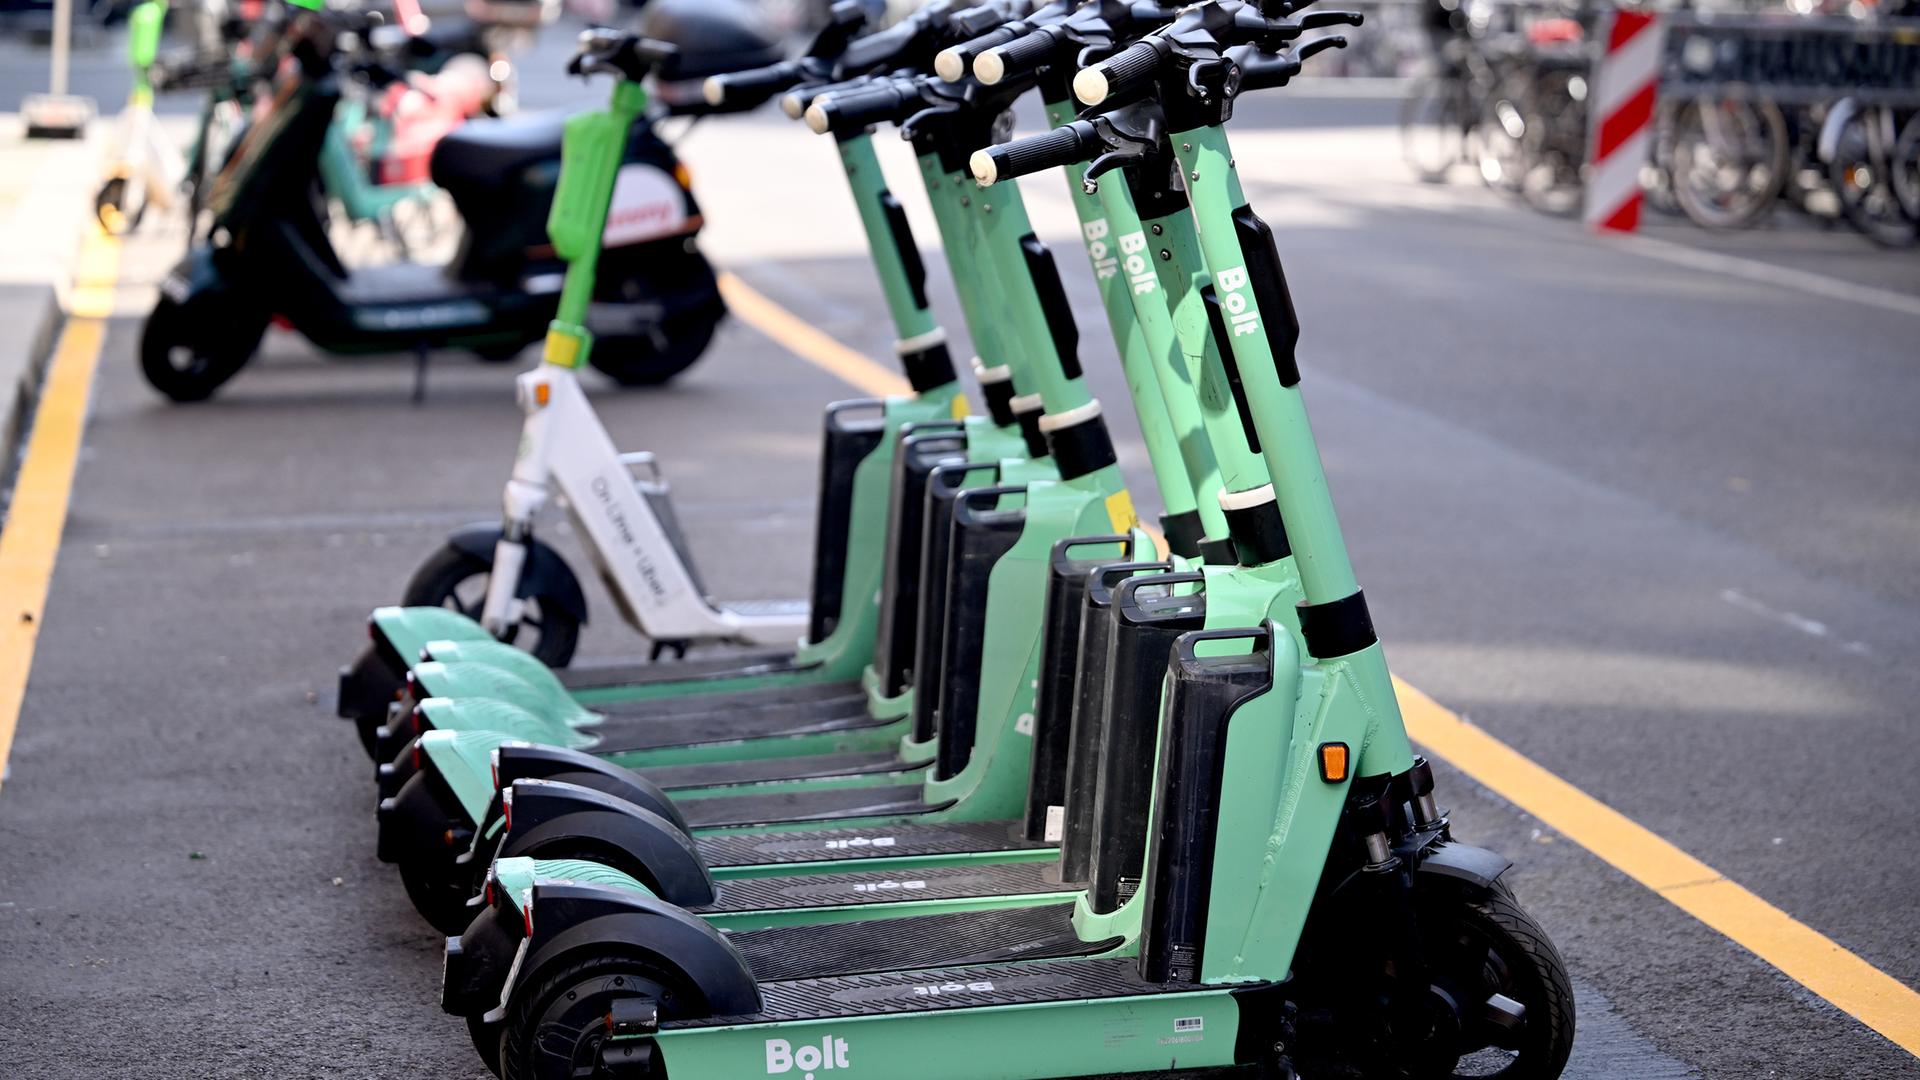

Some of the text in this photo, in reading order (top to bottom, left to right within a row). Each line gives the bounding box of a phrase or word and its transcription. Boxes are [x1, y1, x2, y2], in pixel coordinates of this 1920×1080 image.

[1083, 218, 1118, 279] Bolt
[1118, 231, 1156, 296] Bolt
[1216, 265, 1259, 337] Bolt
[825, 837, 895, 849] Bolt
[853, 880, 926, 892] Bolt
[913, 982, 995, 995] Bolt
[765, 1034, 850, 1080] Bolt
